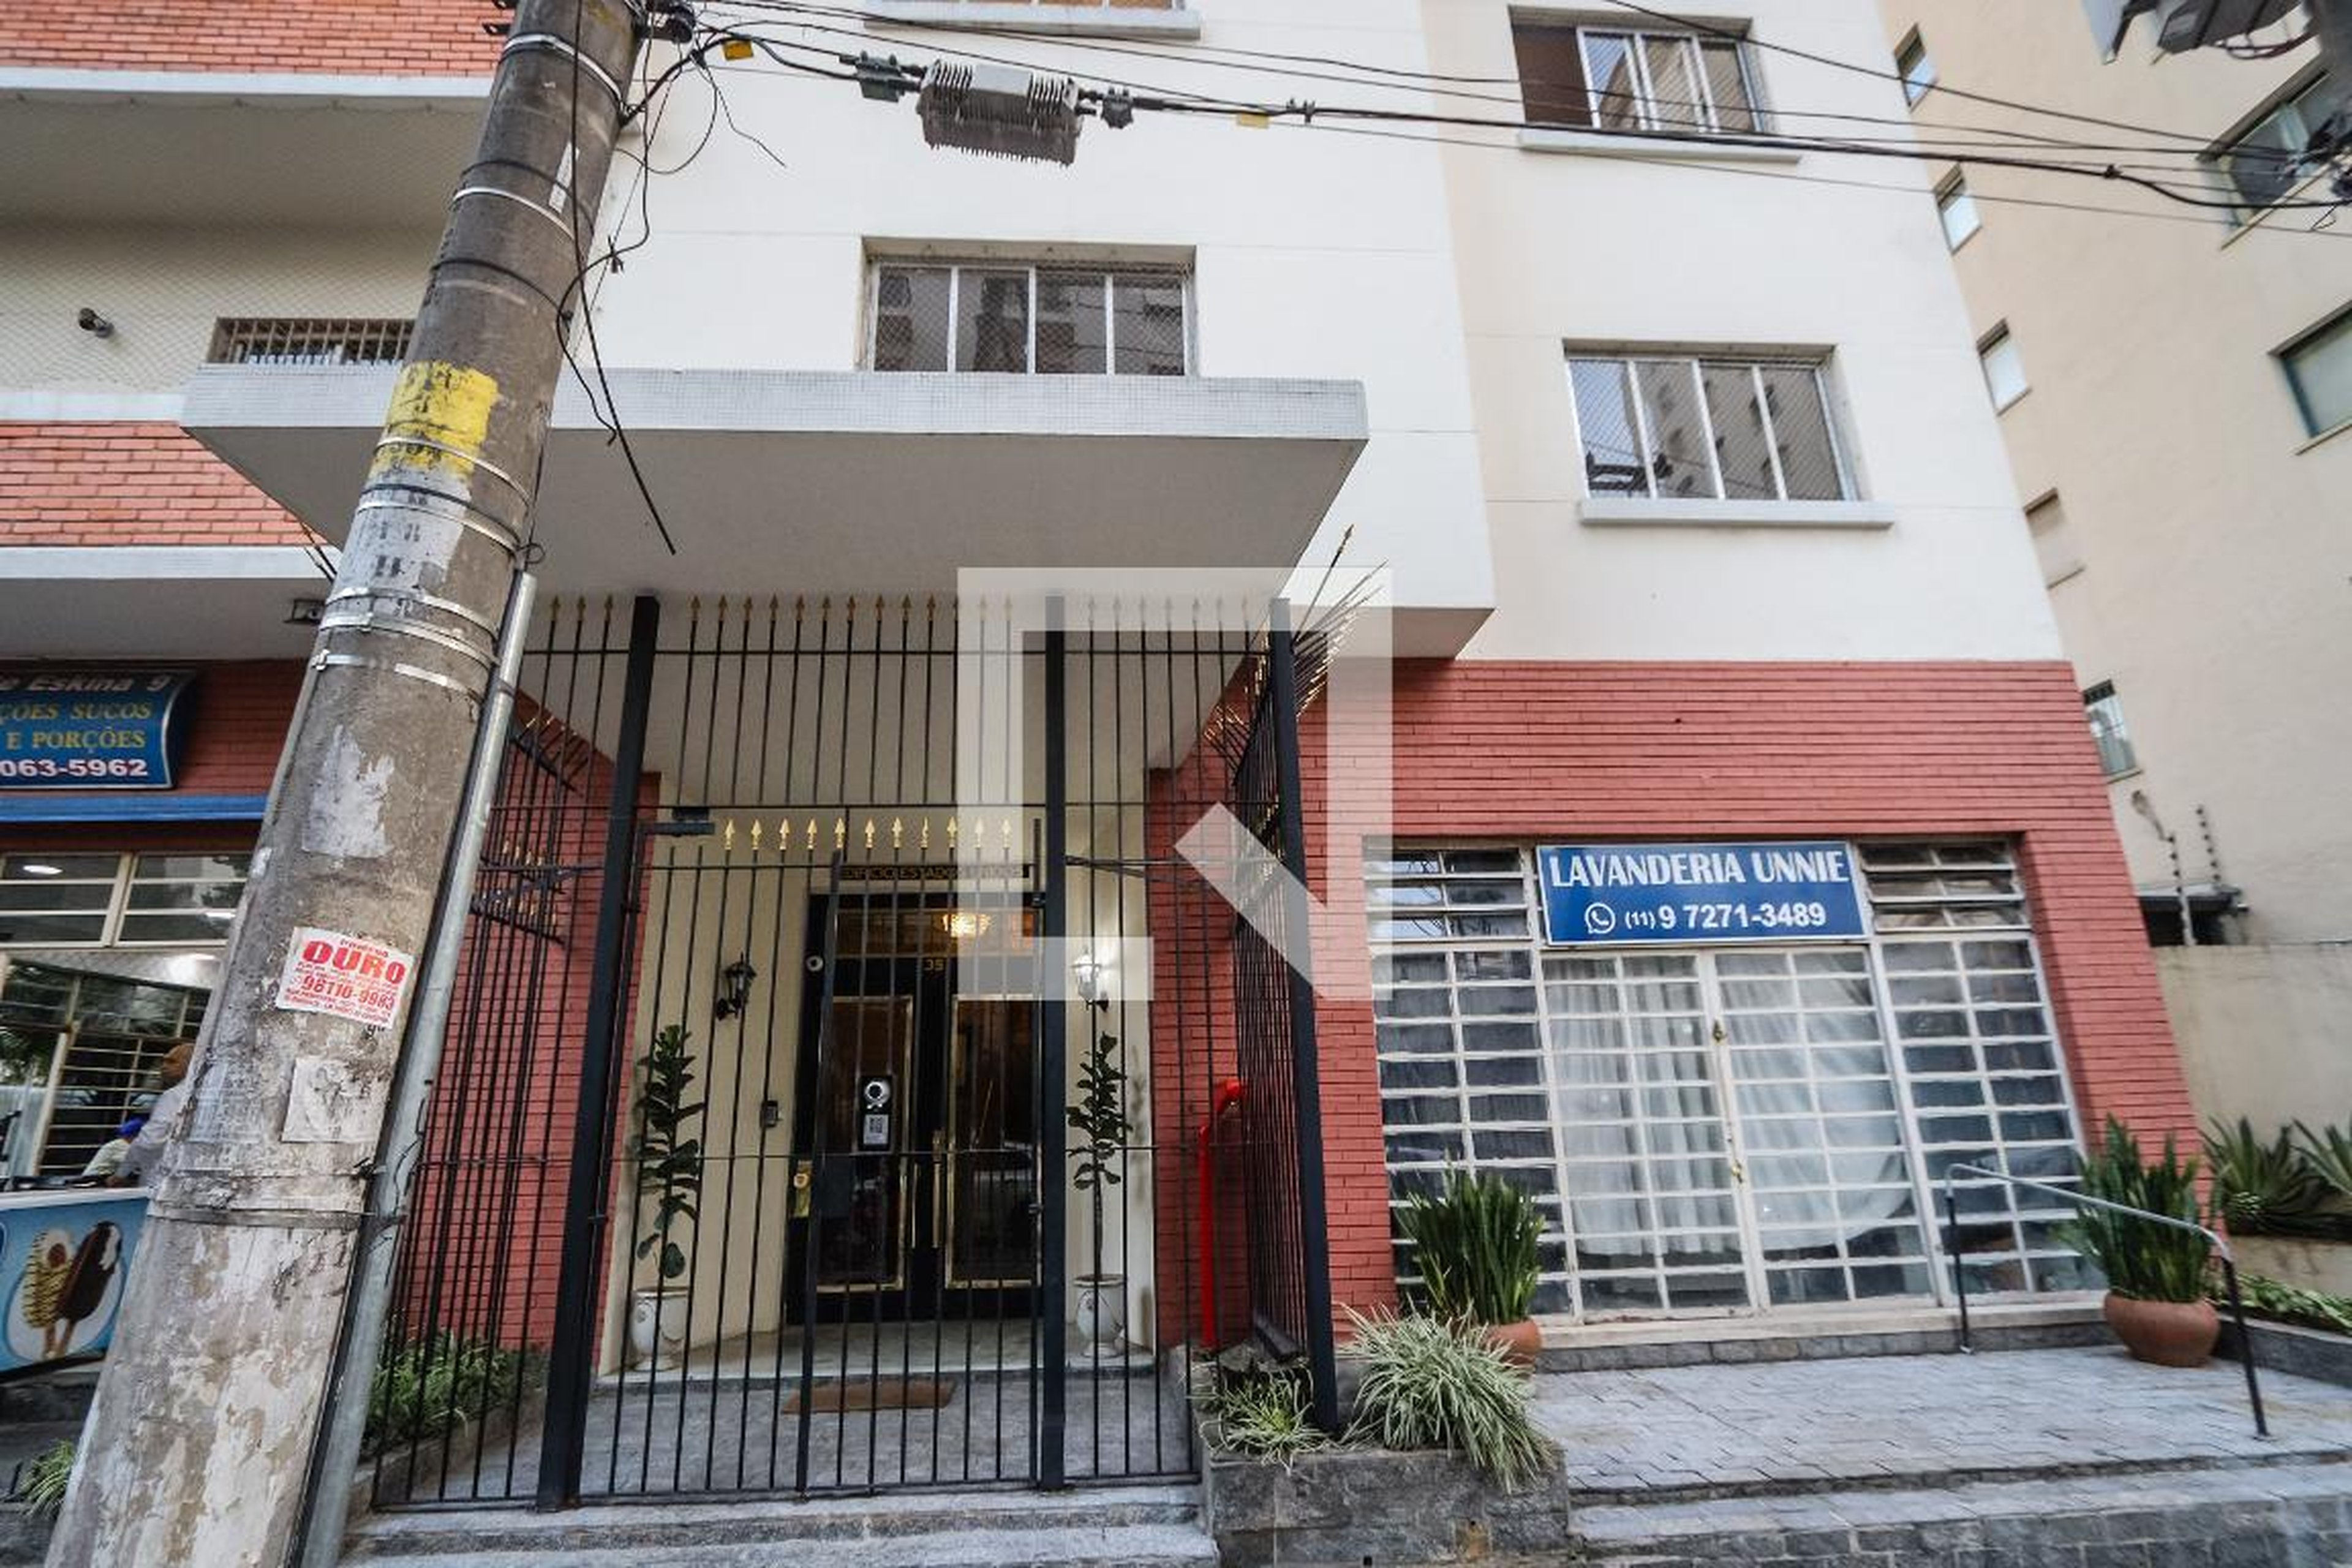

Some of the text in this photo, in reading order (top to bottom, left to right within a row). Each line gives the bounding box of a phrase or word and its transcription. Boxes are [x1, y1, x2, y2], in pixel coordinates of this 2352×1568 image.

[70, 703, 153, 720] SUCOS
[6, 726, 146, 753] E PORÇÕES
[0, 759, 148, 777] 063-5962
[1548, 851, 1849, 887] LAVANDERIA UNNIE
[1625, 902, 1826, 930] (11) 9 7271-3489
